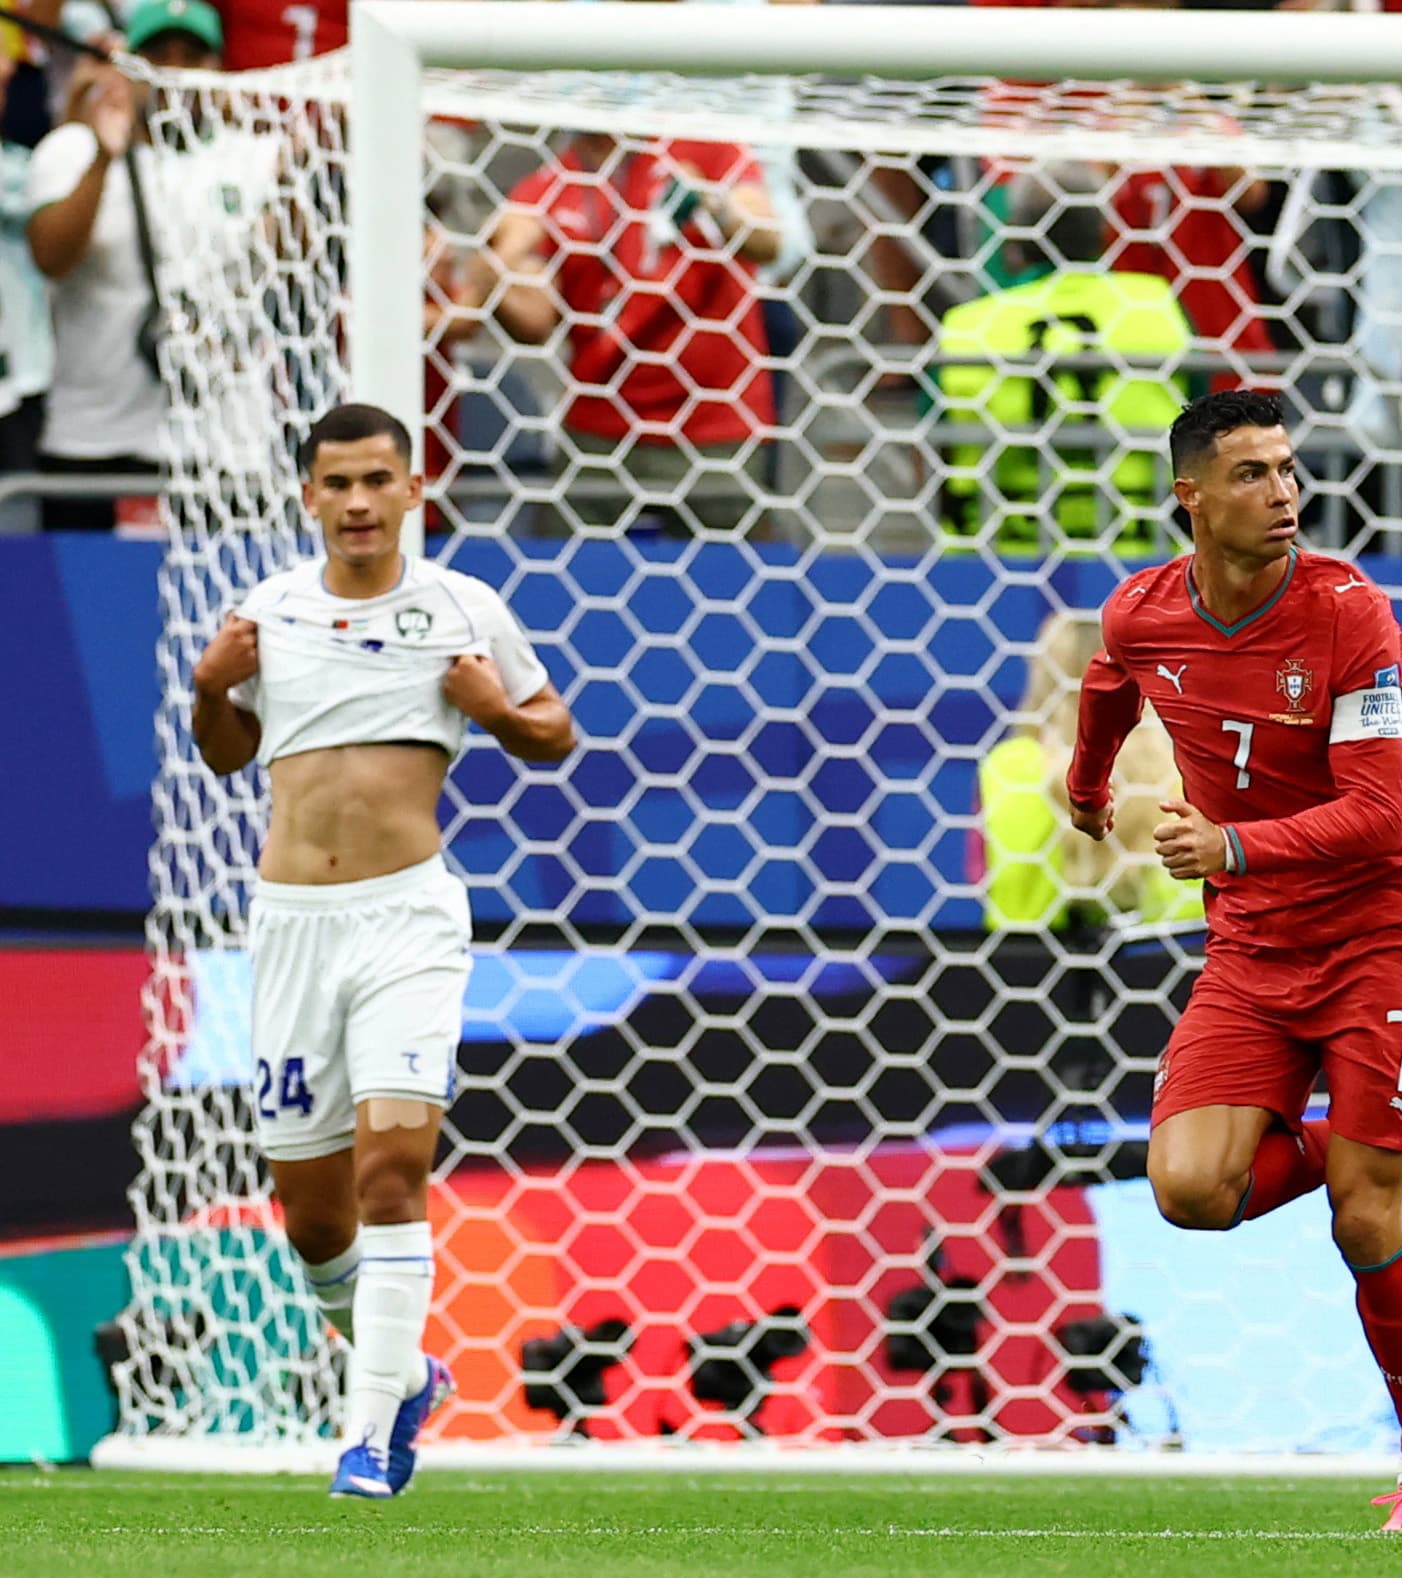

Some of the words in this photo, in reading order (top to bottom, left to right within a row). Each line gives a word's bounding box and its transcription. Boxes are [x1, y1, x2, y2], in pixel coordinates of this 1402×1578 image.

[1363, 692, 1399, 704] FOOTBA
[1222, 719, 1254, 790] 7
[258, 1057, 314, 1118] 24
